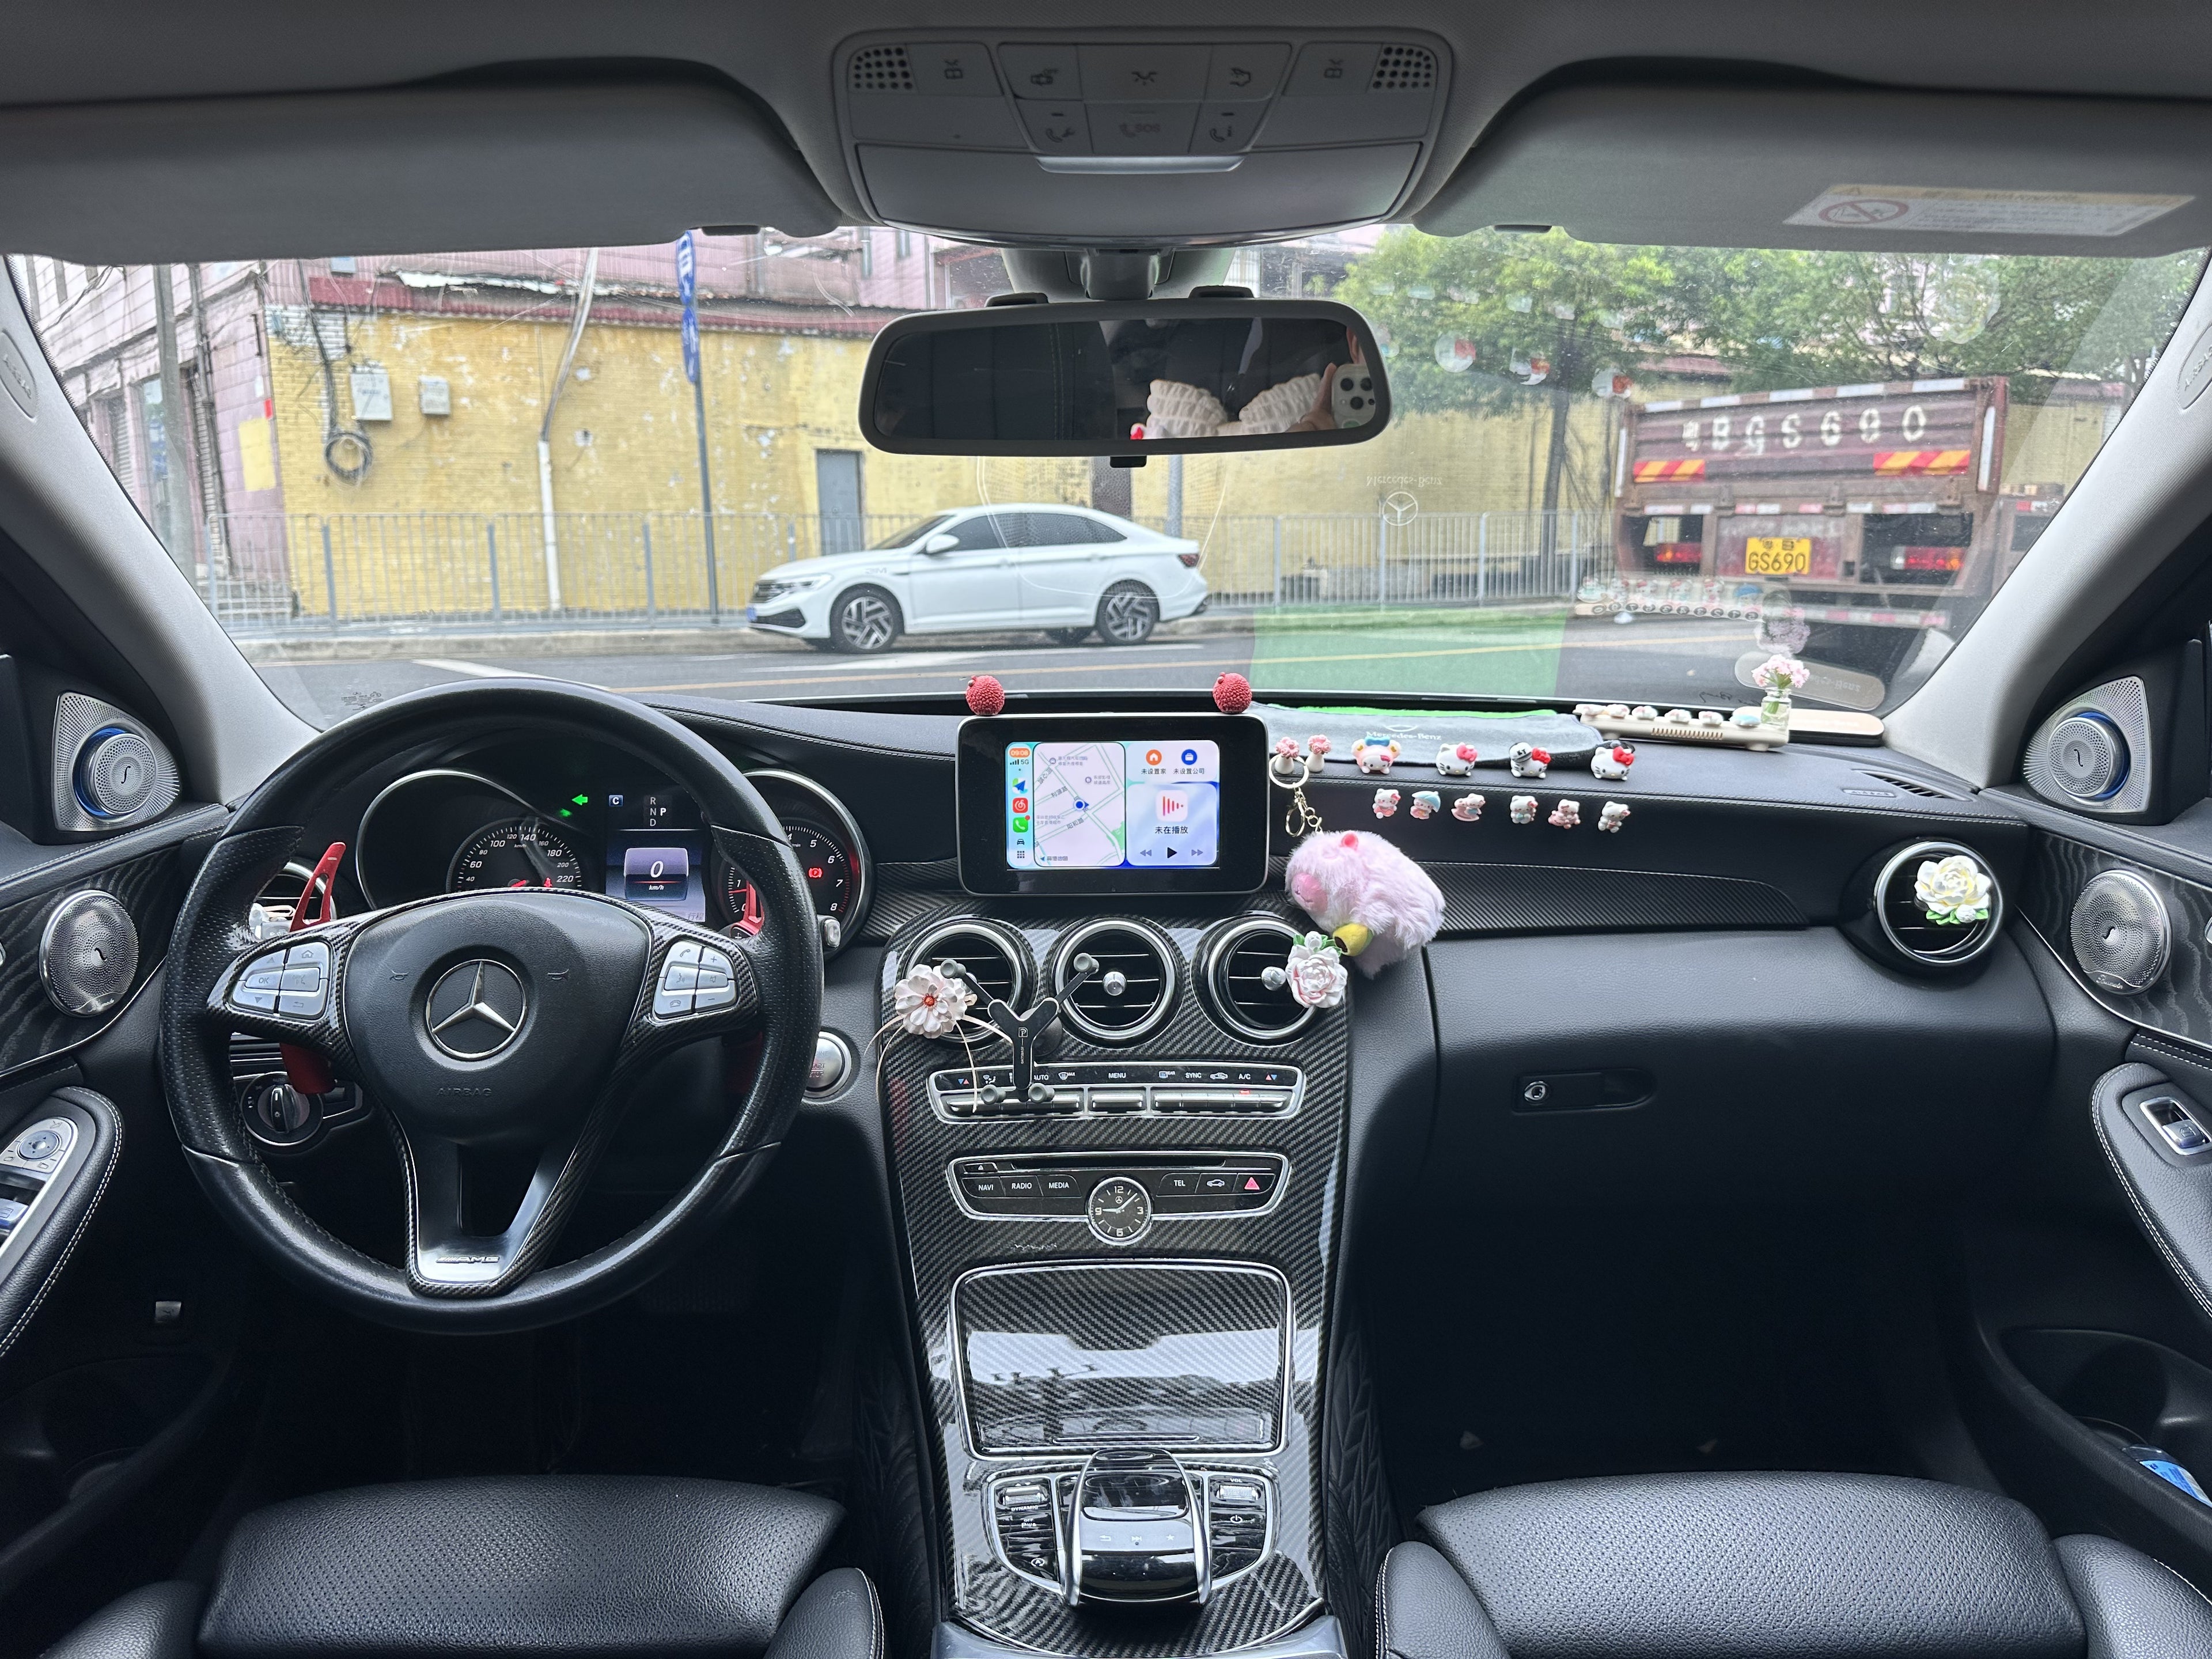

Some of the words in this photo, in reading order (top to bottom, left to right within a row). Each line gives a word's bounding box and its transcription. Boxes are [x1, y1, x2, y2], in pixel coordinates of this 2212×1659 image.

[1749, 552, 1806, 571] GS690
[612, 797, 620, 805] C
[650, 808, 657, 816] N
[660, 807, 666, 816] P
[1155, 826, 1188, 834] 未在播放
[810, 839, 817, 848] 5
[650, 861, 664, 878] 0
[836, 880, 843, 888] 7
[830, 903, 838, 911] 8
[259, 976, 269, 984] OK
[437, 1087, 493, 1097] AIRBAG
[1114, 1185, 1124, 1194] 12
[1094, 1207, 1102, 1215] 9
[1137, 1206, 1143, 1214] 3
[1116, 1228, 1123, 1236] 6
